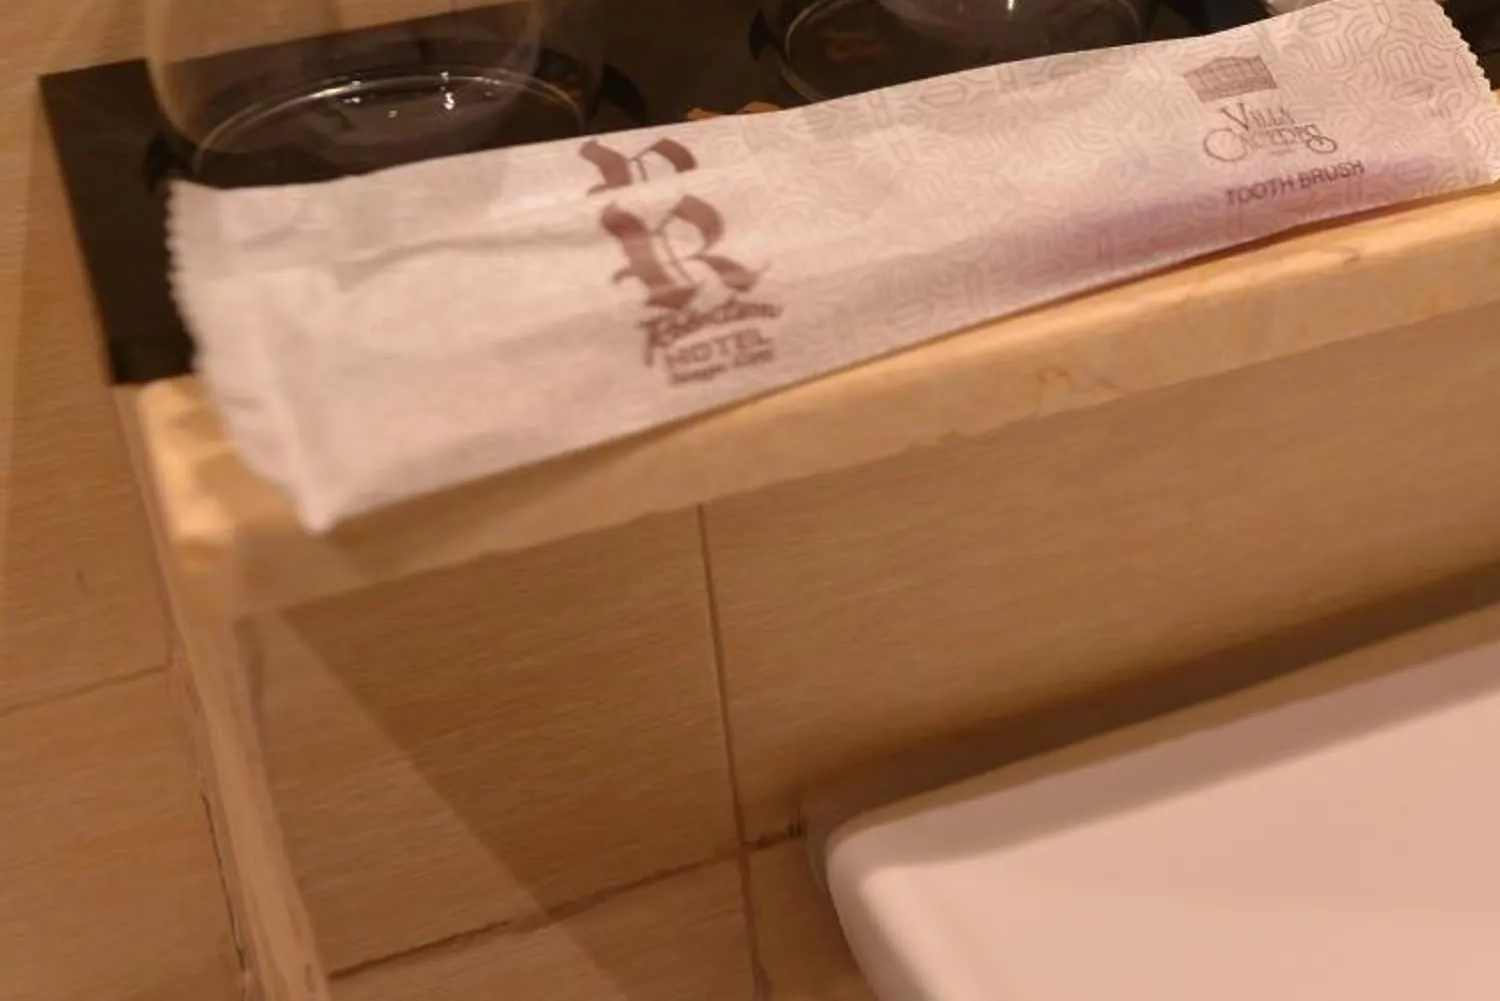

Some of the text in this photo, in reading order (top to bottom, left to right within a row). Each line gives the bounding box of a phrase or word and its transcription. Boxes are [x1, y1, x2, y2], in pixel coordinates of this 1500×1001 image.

[1226, 160, 1365, 204] TOOTH BRUSH
[600, 194, 772, 309] R
[665, 327, 774, 371] HOTEL
